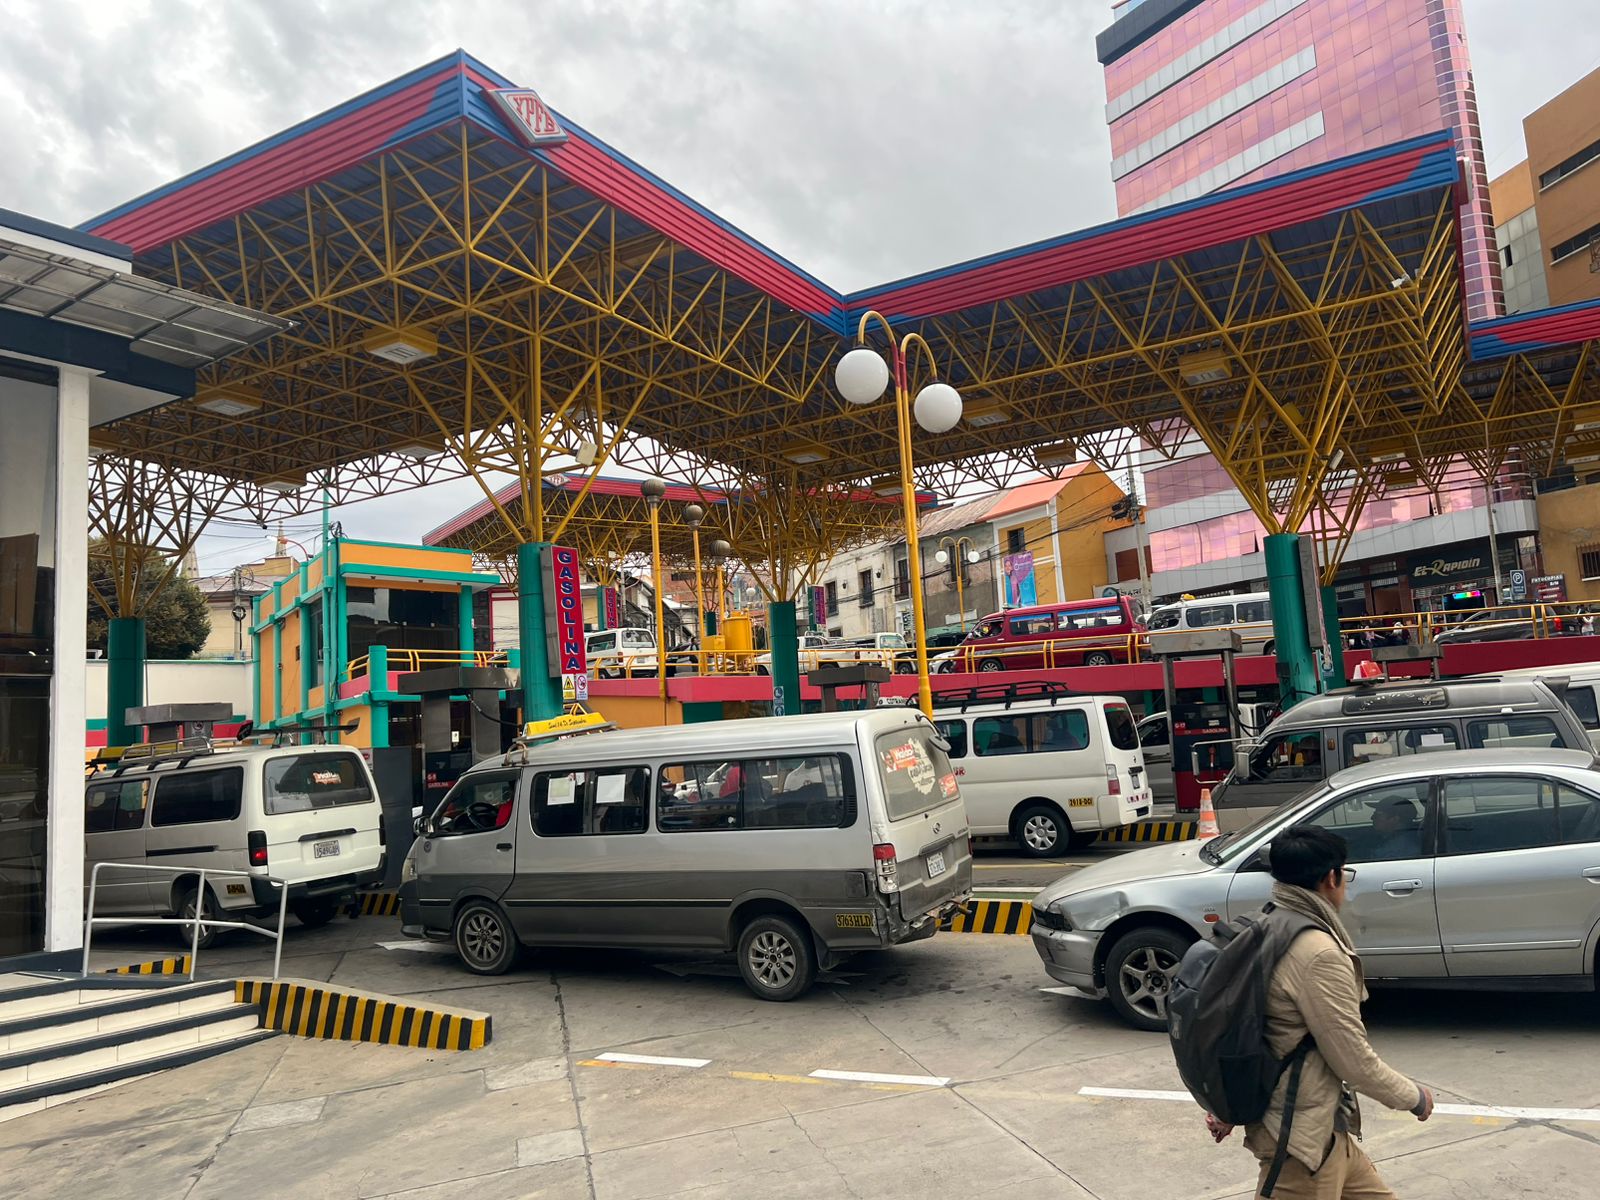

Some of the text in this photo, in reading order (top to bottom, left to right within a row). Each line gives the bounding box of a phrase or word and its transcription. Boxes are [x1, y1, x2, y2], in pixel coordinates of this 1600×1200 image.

[514, 96, 555, 132] YPFB
[557, 550, 581, 671] GASOLINA
[836, 914, 872, 927] 3763HLD
